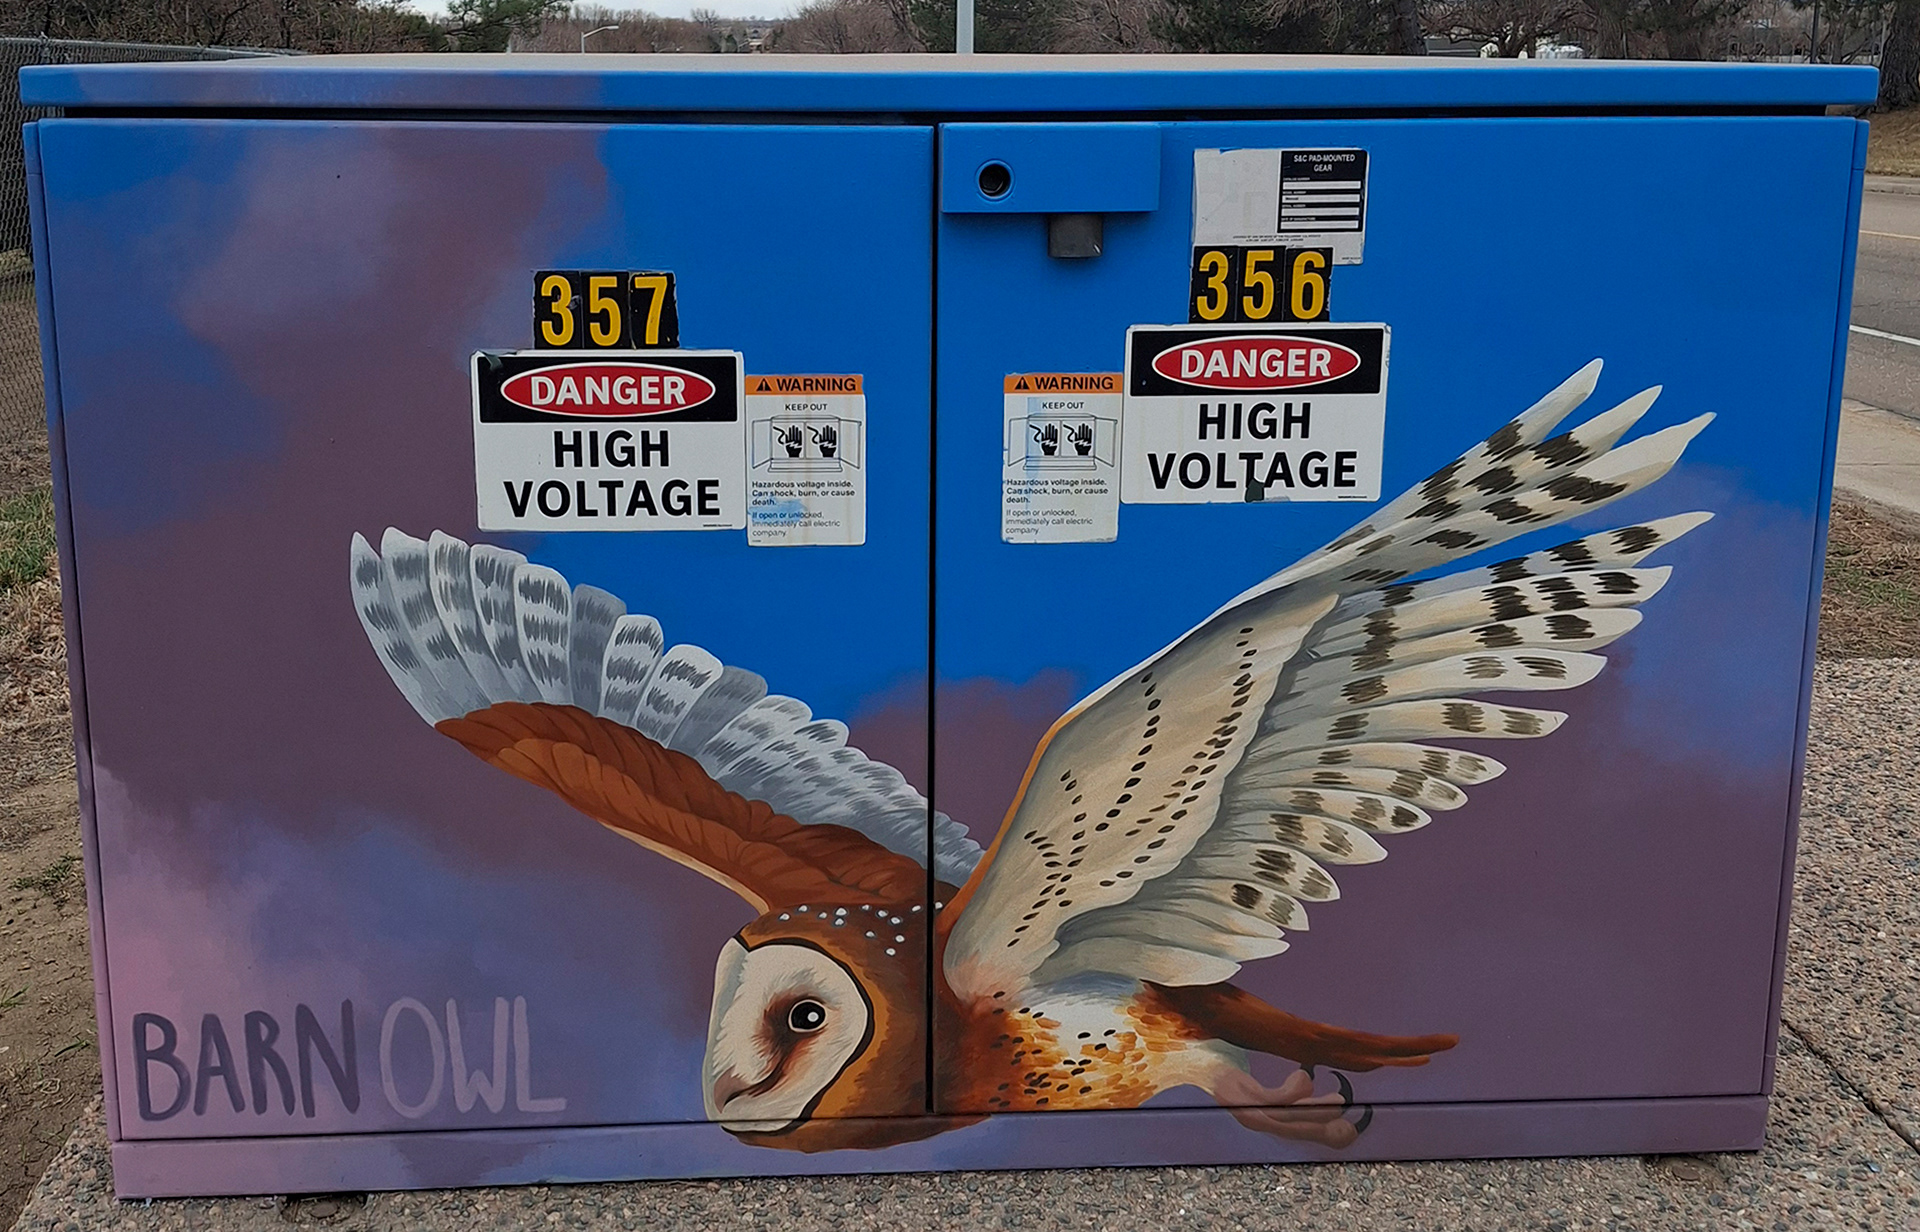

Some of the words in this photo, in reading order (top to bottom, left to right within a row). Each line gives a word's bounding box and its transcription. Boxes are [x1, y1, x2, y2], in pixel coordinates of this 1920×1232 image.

[1309, 154, 1355, 162] PAD-MOUNTED
[1313, 164, 1332, 172] GEAR
[1197, 250, 1325, 320] 356
[541, 274, 668, 346] 357
[1181, 348, 1332, 378] DANGER
[777, 378, 856, 391] WARNING
[1035, 377, 1114, 390] WARNING
[530, 376, 686, 406] DANGER
[785, 403, 808, 411] KEEP
[810, 403, 828, 411] OUT
[1198, 402, 1311, 440] HIGH
[554, 430, 669, 468] HIGH
[1147, 451, 1357, 489] VOLTAGE
[796, 481, 826, 489] voltage
[827, 480, 854, 488] inside.
[1051, 479, 1079, 487] voltage
[1081, 478, 1107, 486] inside.
[770, 490, 797, 498] shock,
[798, 490, 819, 498] burn,
[1024, 487, 1051, 495] shock,
[1051, 487, 1073, 495] burn,
[503, 479, 720, 517] VOLTAGE
[752, 498, 777, 506] death.
[759, 512, 778, 520] open
[1012, 510, 1031, 518] open
[752, 520, 797, 528] immediately
[1006, 518, 1050, 526] immediately
[1051, 517, 1065, 525] call
[1066, 517, 1093, 525] electric
[132, 998, 360, 1121] BARN
[379, 995, 567, 1119] OWL
